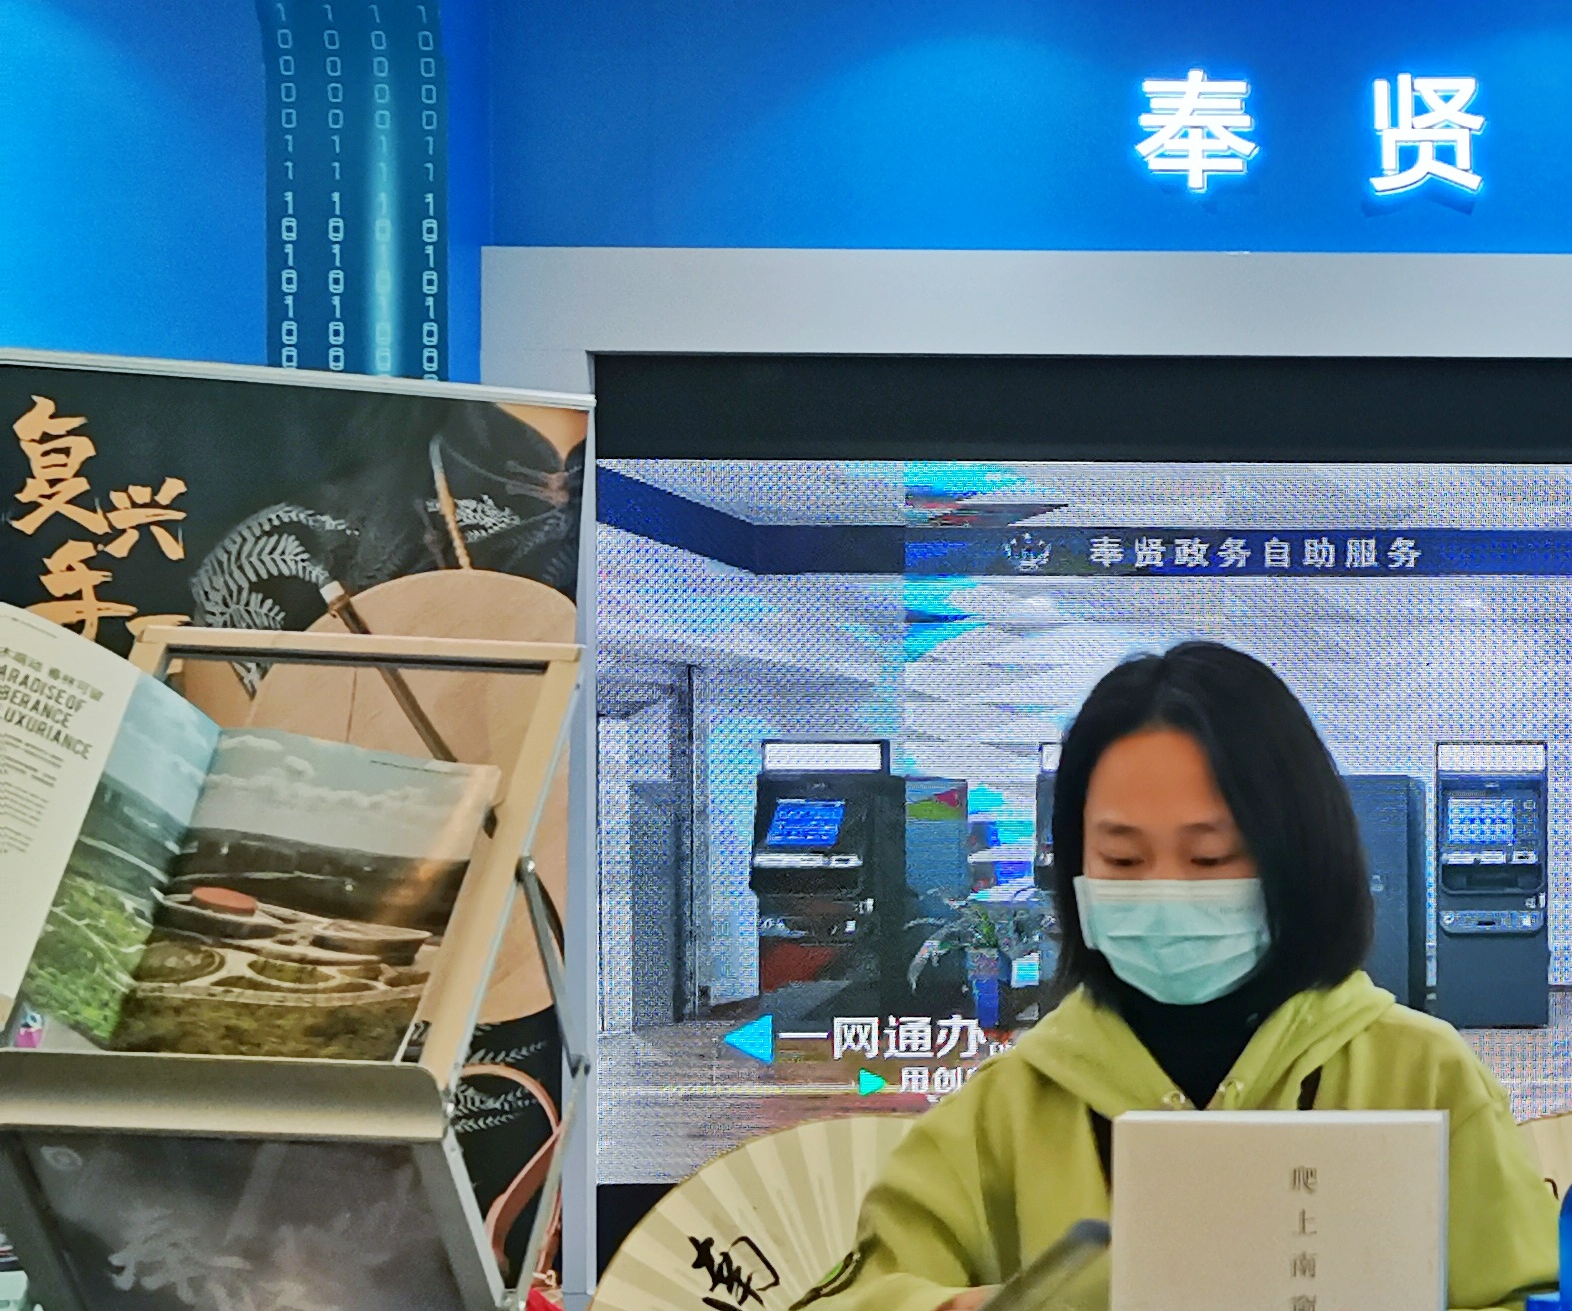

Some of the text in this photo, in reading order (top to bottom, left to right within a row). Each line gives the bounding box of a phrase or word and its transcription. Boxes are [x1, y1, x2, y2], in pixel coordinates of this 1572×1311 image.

[1089, 535, 1422, 569] 奉贤政务自助服务
[0, 707, 93, 760] UXURIANCE
[778, 1014, 988, 1060] 一网通办
